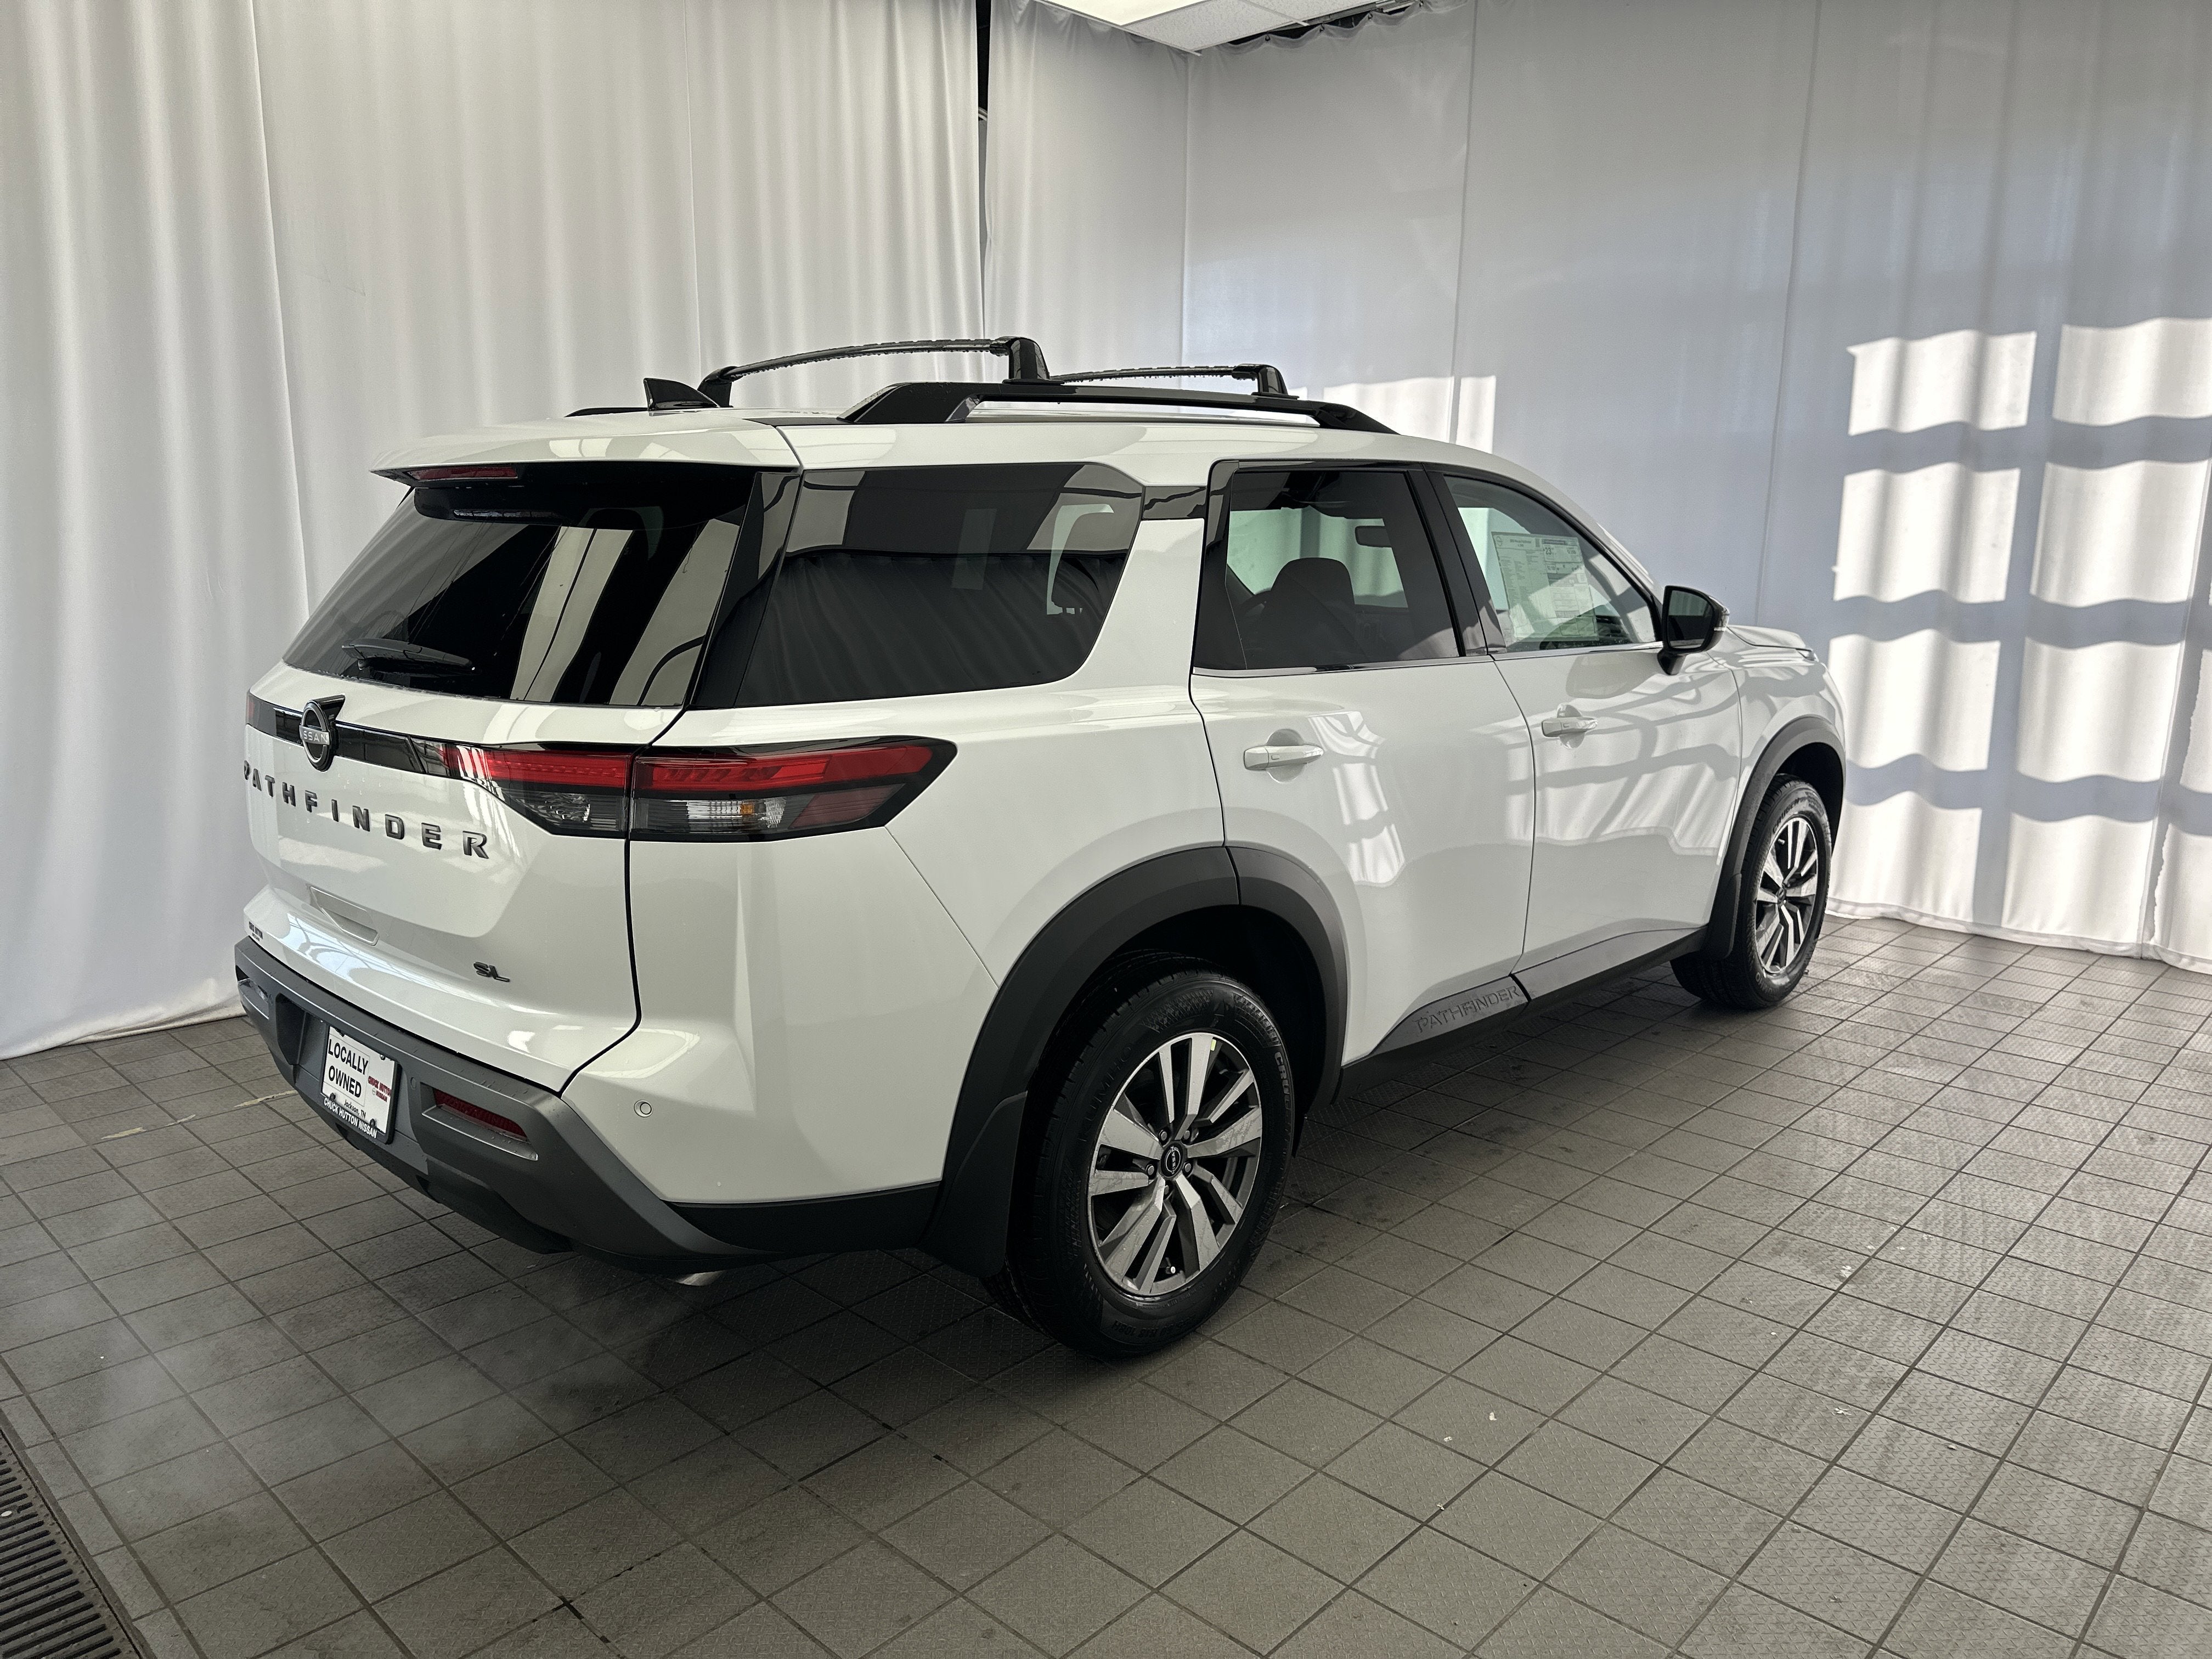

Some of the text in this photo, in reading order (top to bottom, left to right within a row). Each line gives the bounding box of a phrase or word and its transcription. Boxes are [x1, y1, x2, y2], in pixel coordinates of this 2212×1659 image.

[302, 730, 328, 743] SSAN
[243, 760, 489, 860] PATHFINDER
[472, 961, 510, 983] SL
[1413, 985, 1520, 1034] PATHFINDER
[328, 1039, 369, 1075] LOCALLY
[328, 1065, 362, 1098] OWNED
[324, 1097, 377, 1138] CHUCK HUTTON NISSAN
[360, 1109, 366, 1119] TN
